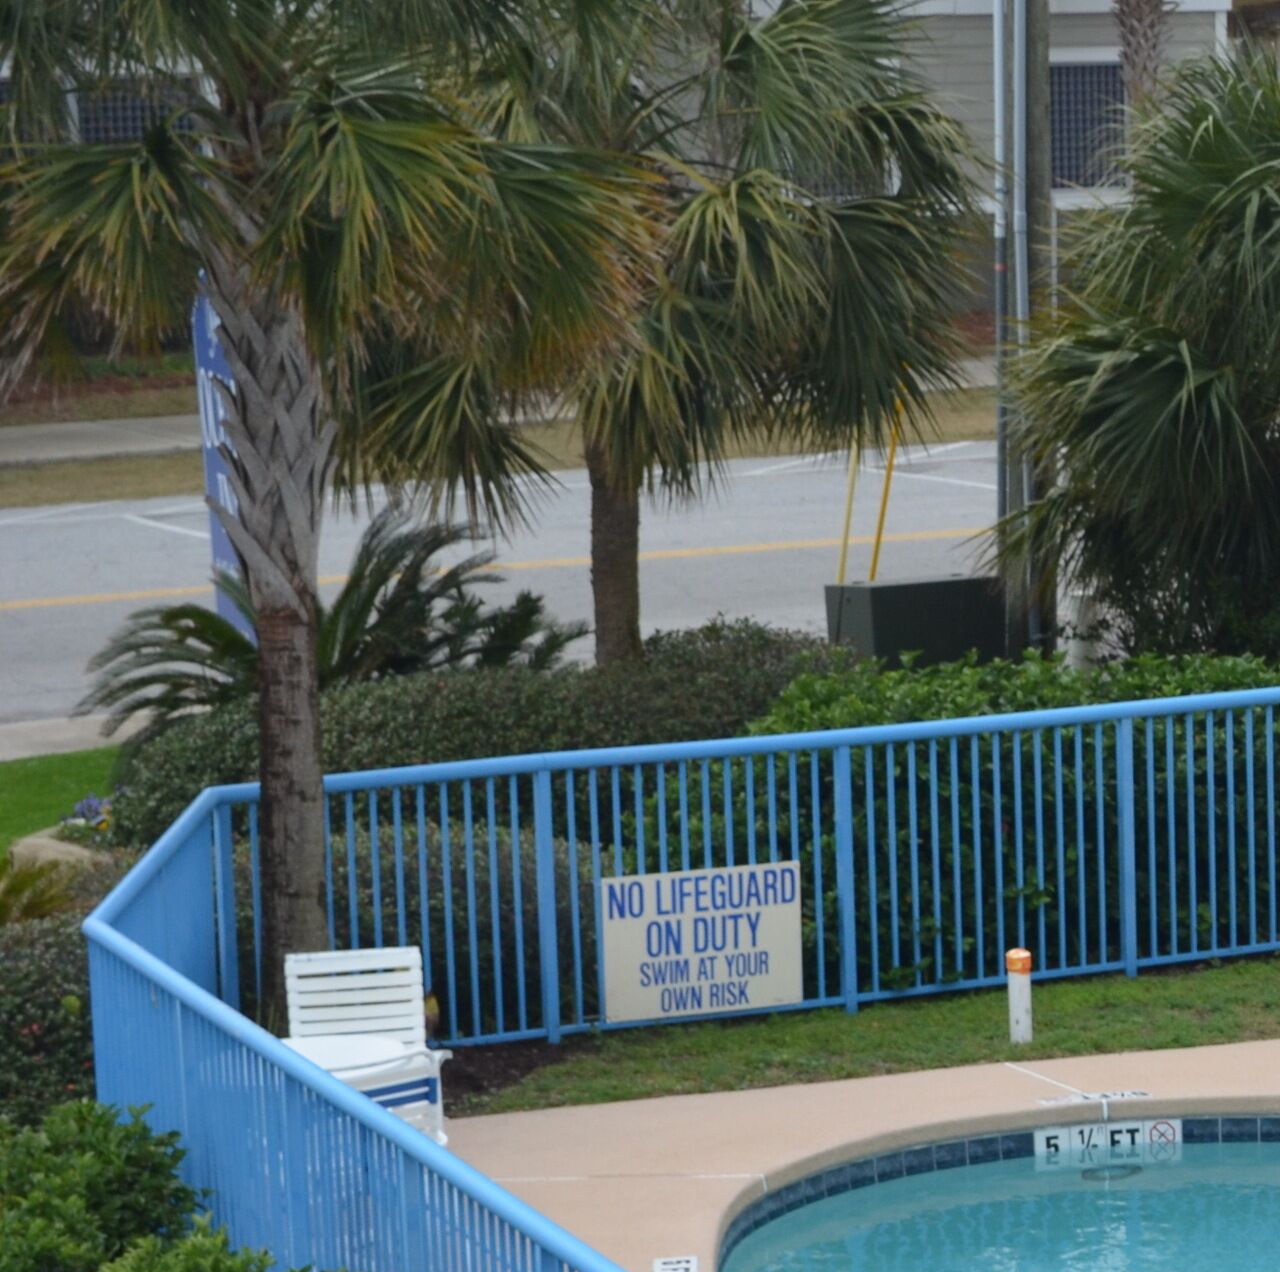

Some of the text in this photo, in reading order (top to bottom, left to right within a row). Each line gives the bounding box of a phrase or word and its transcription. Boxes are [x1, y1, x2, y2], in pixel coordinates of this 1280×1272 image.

[608, 867, 796, 920] NO LIFEGUARD
[646, 912, 760, 957] ON DUTY
[640, 951, 769, 987] SWIM AT YOUR
[661, 981, 749, 1013] OWN RISK
[1045, 1135, 1060, 1153] 5
[1110, 1128, 1140, 1148] FT
